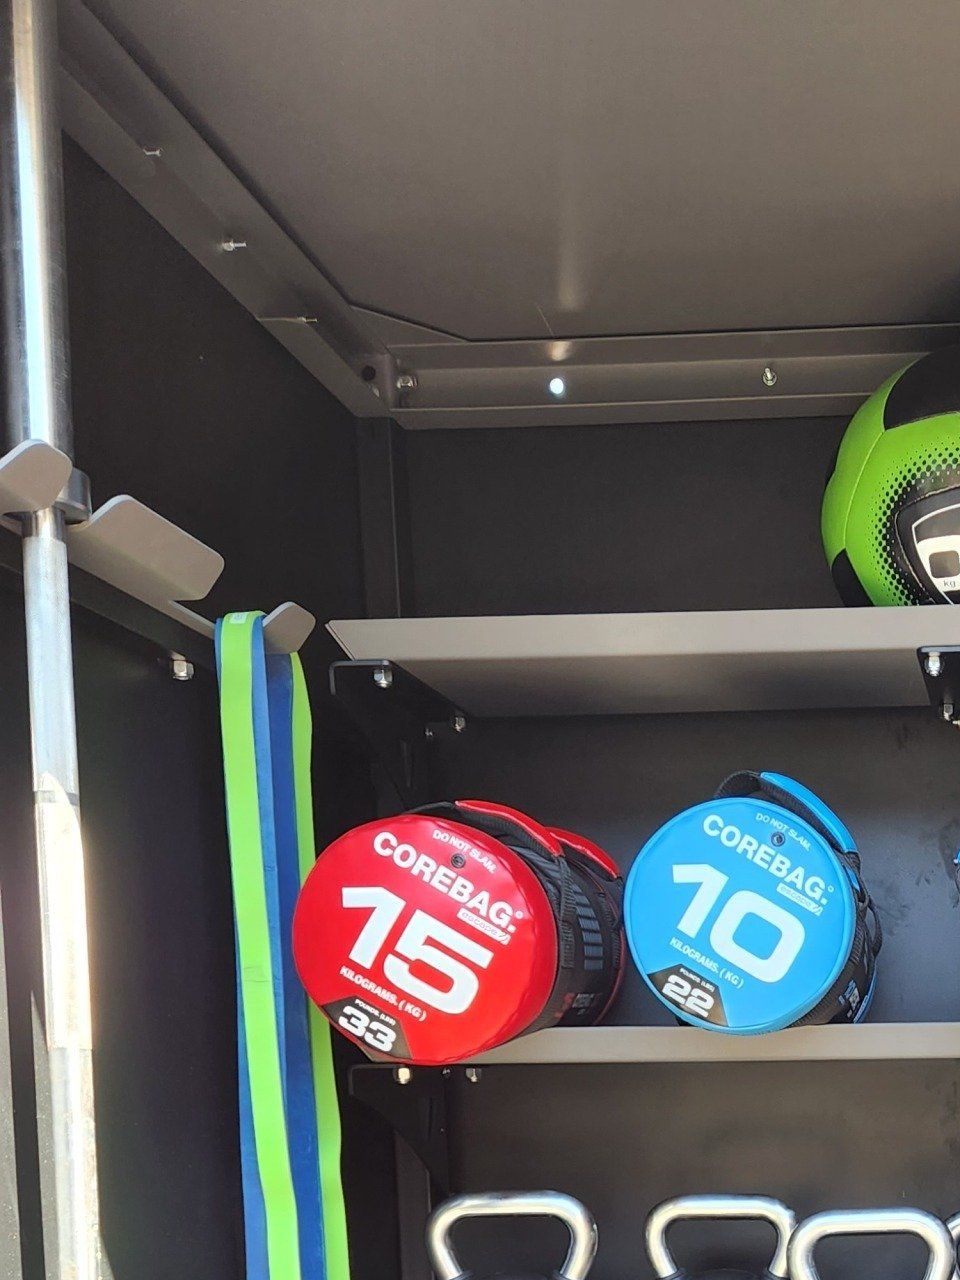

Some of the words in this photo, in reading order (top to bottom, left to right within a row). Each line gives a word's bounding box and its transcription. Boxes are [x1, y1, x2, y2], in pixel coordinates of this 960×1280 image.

[943, 579, 956, 589] kg
[432, 829, 450, 843] DO
[449, 835, 471, 852] NOT
[755, 812, 770, 823] DO
[769, 818, 790, 832] NOT
[671, 863, 806, 983] 10
[341, 886, 494, 1014] 15
[661, 974, 715, 1018] 22
[338, 1005, 397, 1052] 33
